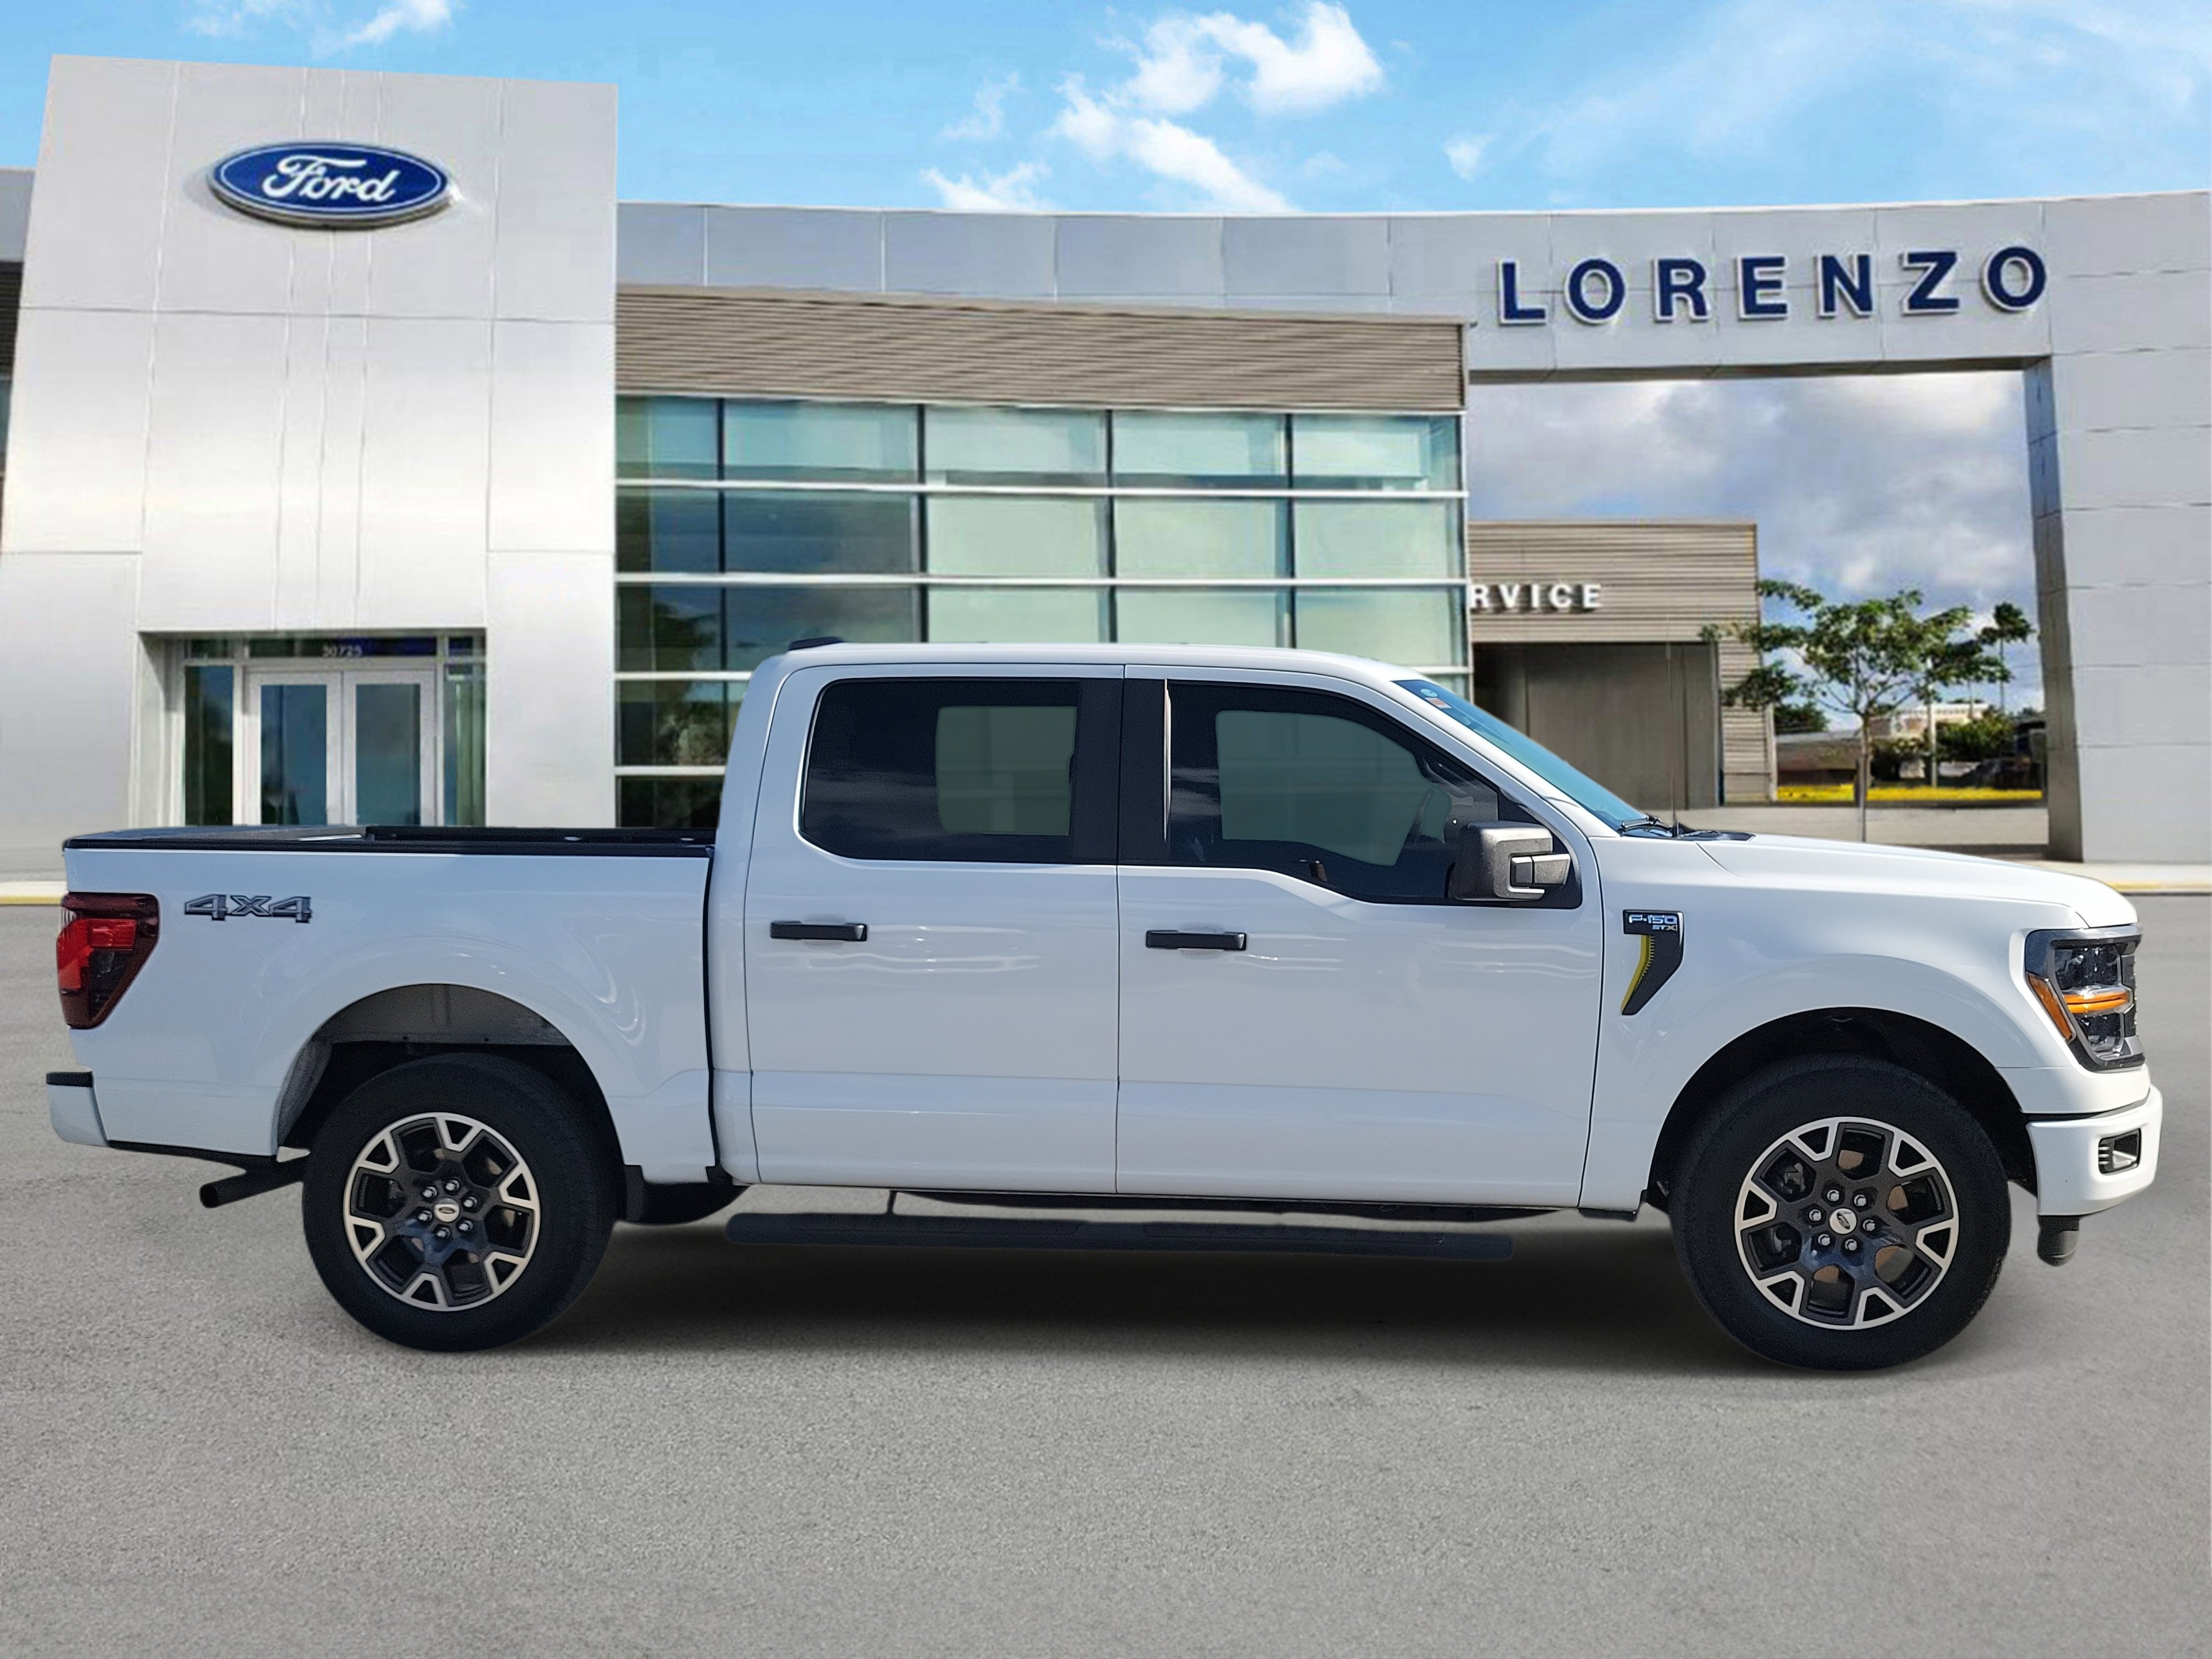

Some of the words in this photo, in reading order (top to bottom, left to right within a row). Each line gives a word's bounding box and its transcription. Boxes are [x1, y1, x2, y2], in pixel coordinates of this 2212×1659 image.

[262, 154, 400, 201] Ford
[1498, 245, 2047, 326] LORENZO
[1470, 583, 1601, 608] RVICE
[1628, 914, 1678, 924] F-150
